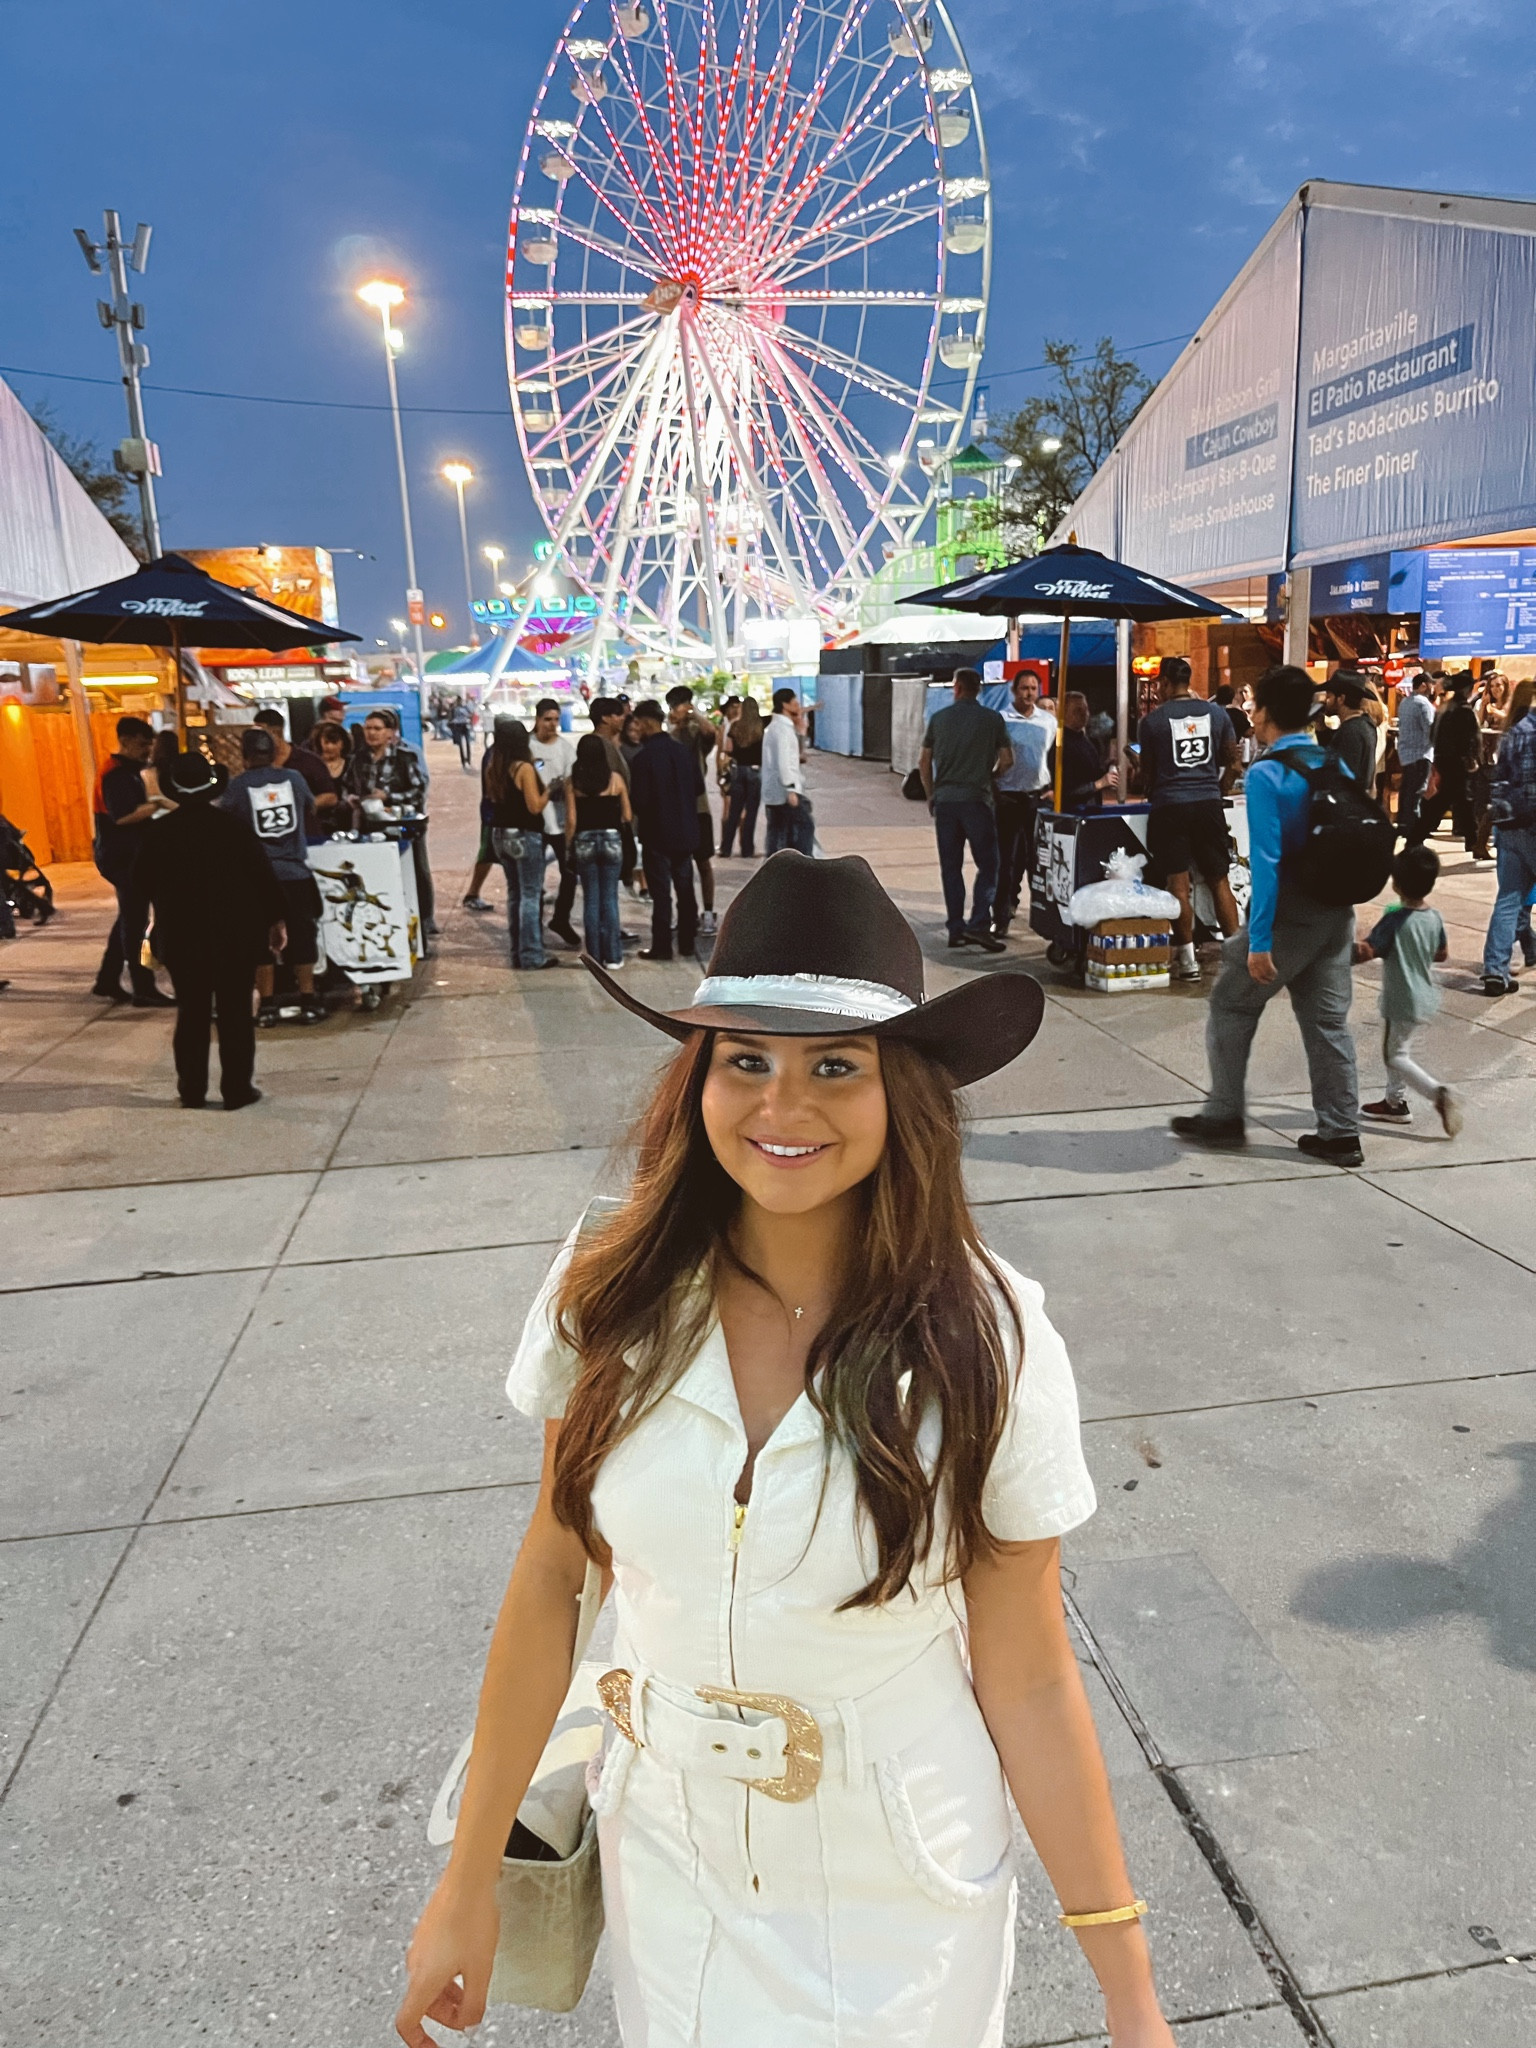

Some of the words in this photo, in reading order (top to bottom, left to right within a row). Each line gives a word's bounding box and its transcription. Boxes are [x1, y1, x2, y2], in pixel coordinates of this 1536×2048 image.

[1312, 308, 1418, 374] Margaritaville
[1310, 389, 1323, 417] El
[1326, 376, 1363, 411] Patio
[1367, 337, 1458, 396] Restaurant
[1202, 433, 1231, 459] Cajun
[1233, 414, 1277, 447] Cowboy
[1308, 426, 1343, 458] Tad's
[1347, 400, 1429, 445] Bodacious
[1434, 377, 1499, 418] Burrito
[1219, 453, 1277, 487] Bar-B-Que
[1306, 473, 1331, 499] The
[1334, 459, 1371, 491] Finer
[1375, 448, 1419, 480] Diner
[1206, 492, 1275, 526] Smokehouse
[1180, 738, 1205, 759] 23
[261, 806, 291, 829] 23
